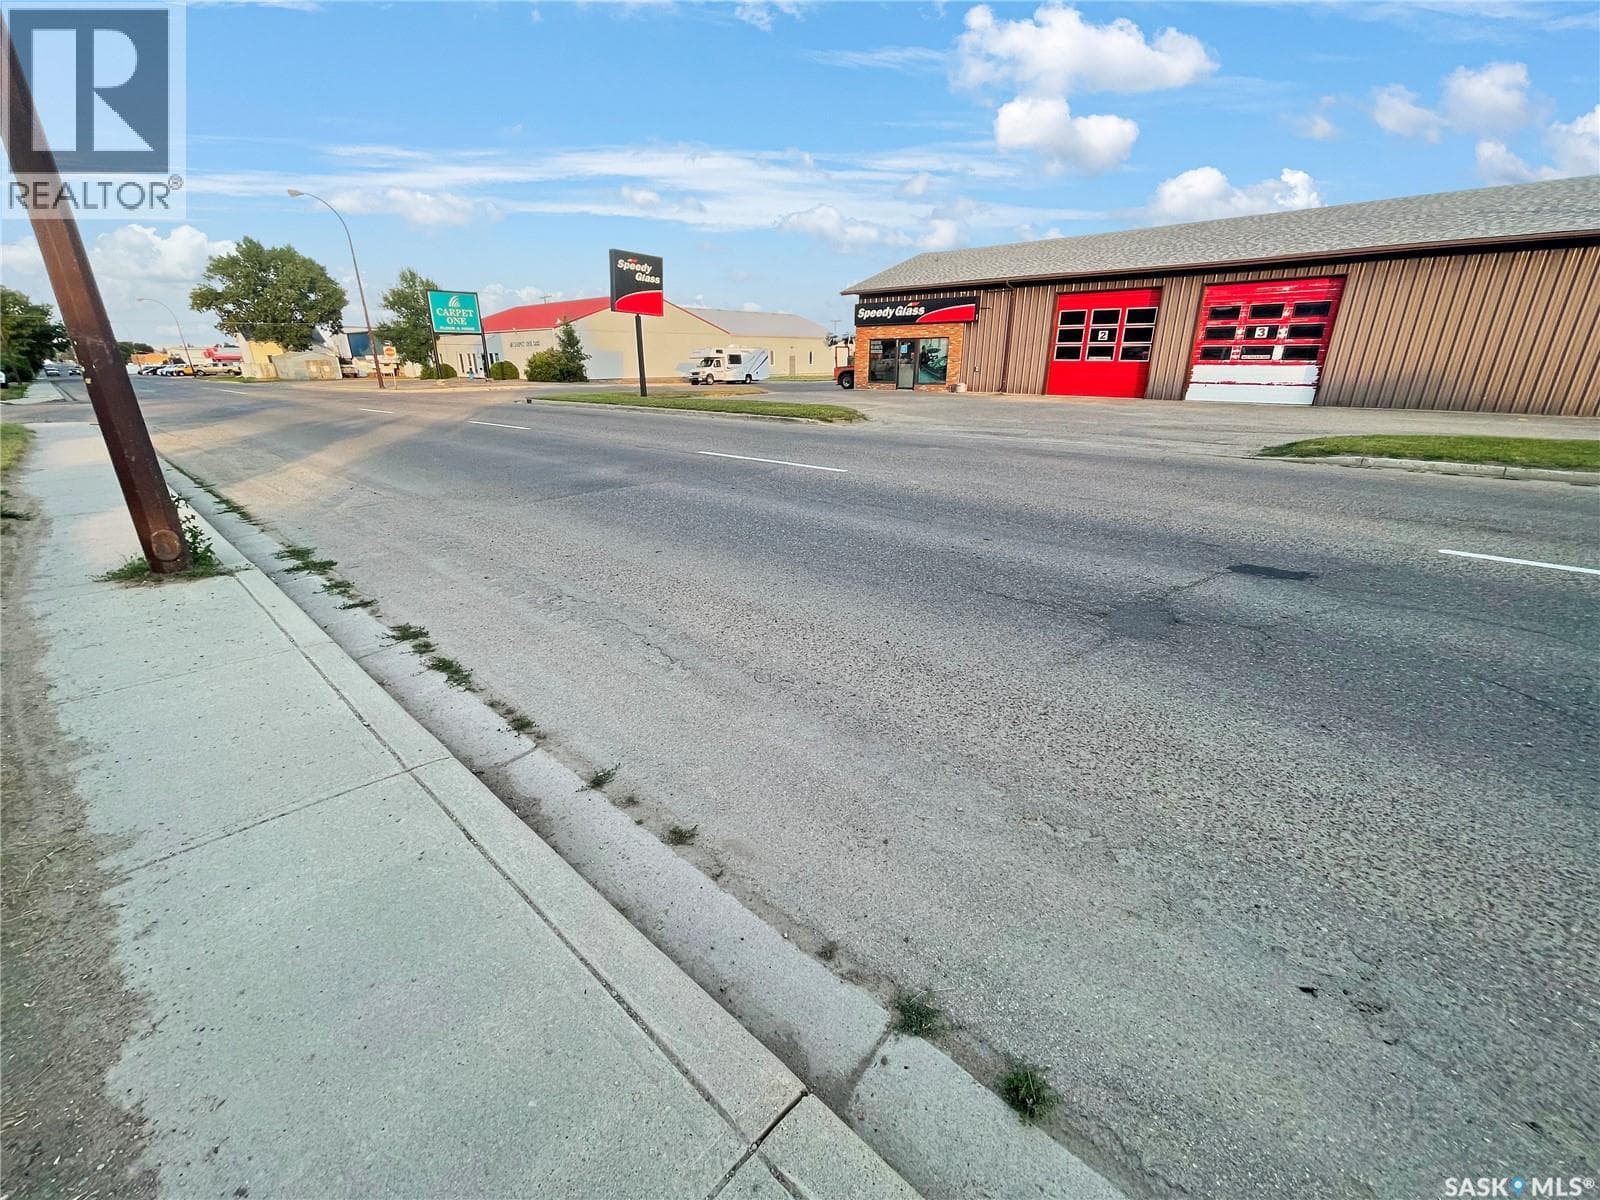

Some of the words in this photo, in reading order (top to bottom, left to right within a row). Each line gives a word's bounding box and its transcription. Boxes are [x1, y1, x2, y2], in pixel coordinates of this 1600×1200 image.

[616, 258, 653, 275] Speedy
[635, 272, 661, 284] Glass
[435, 307, 474, 318] CARPET
[857, 306, 895, 320] Speedy
[895, 304, 926, 317] Glass
[446, 317, 467, 326] ONE
[1100, 331, 1107, 340] 2
[1257, 327, 1266, 337] 3
